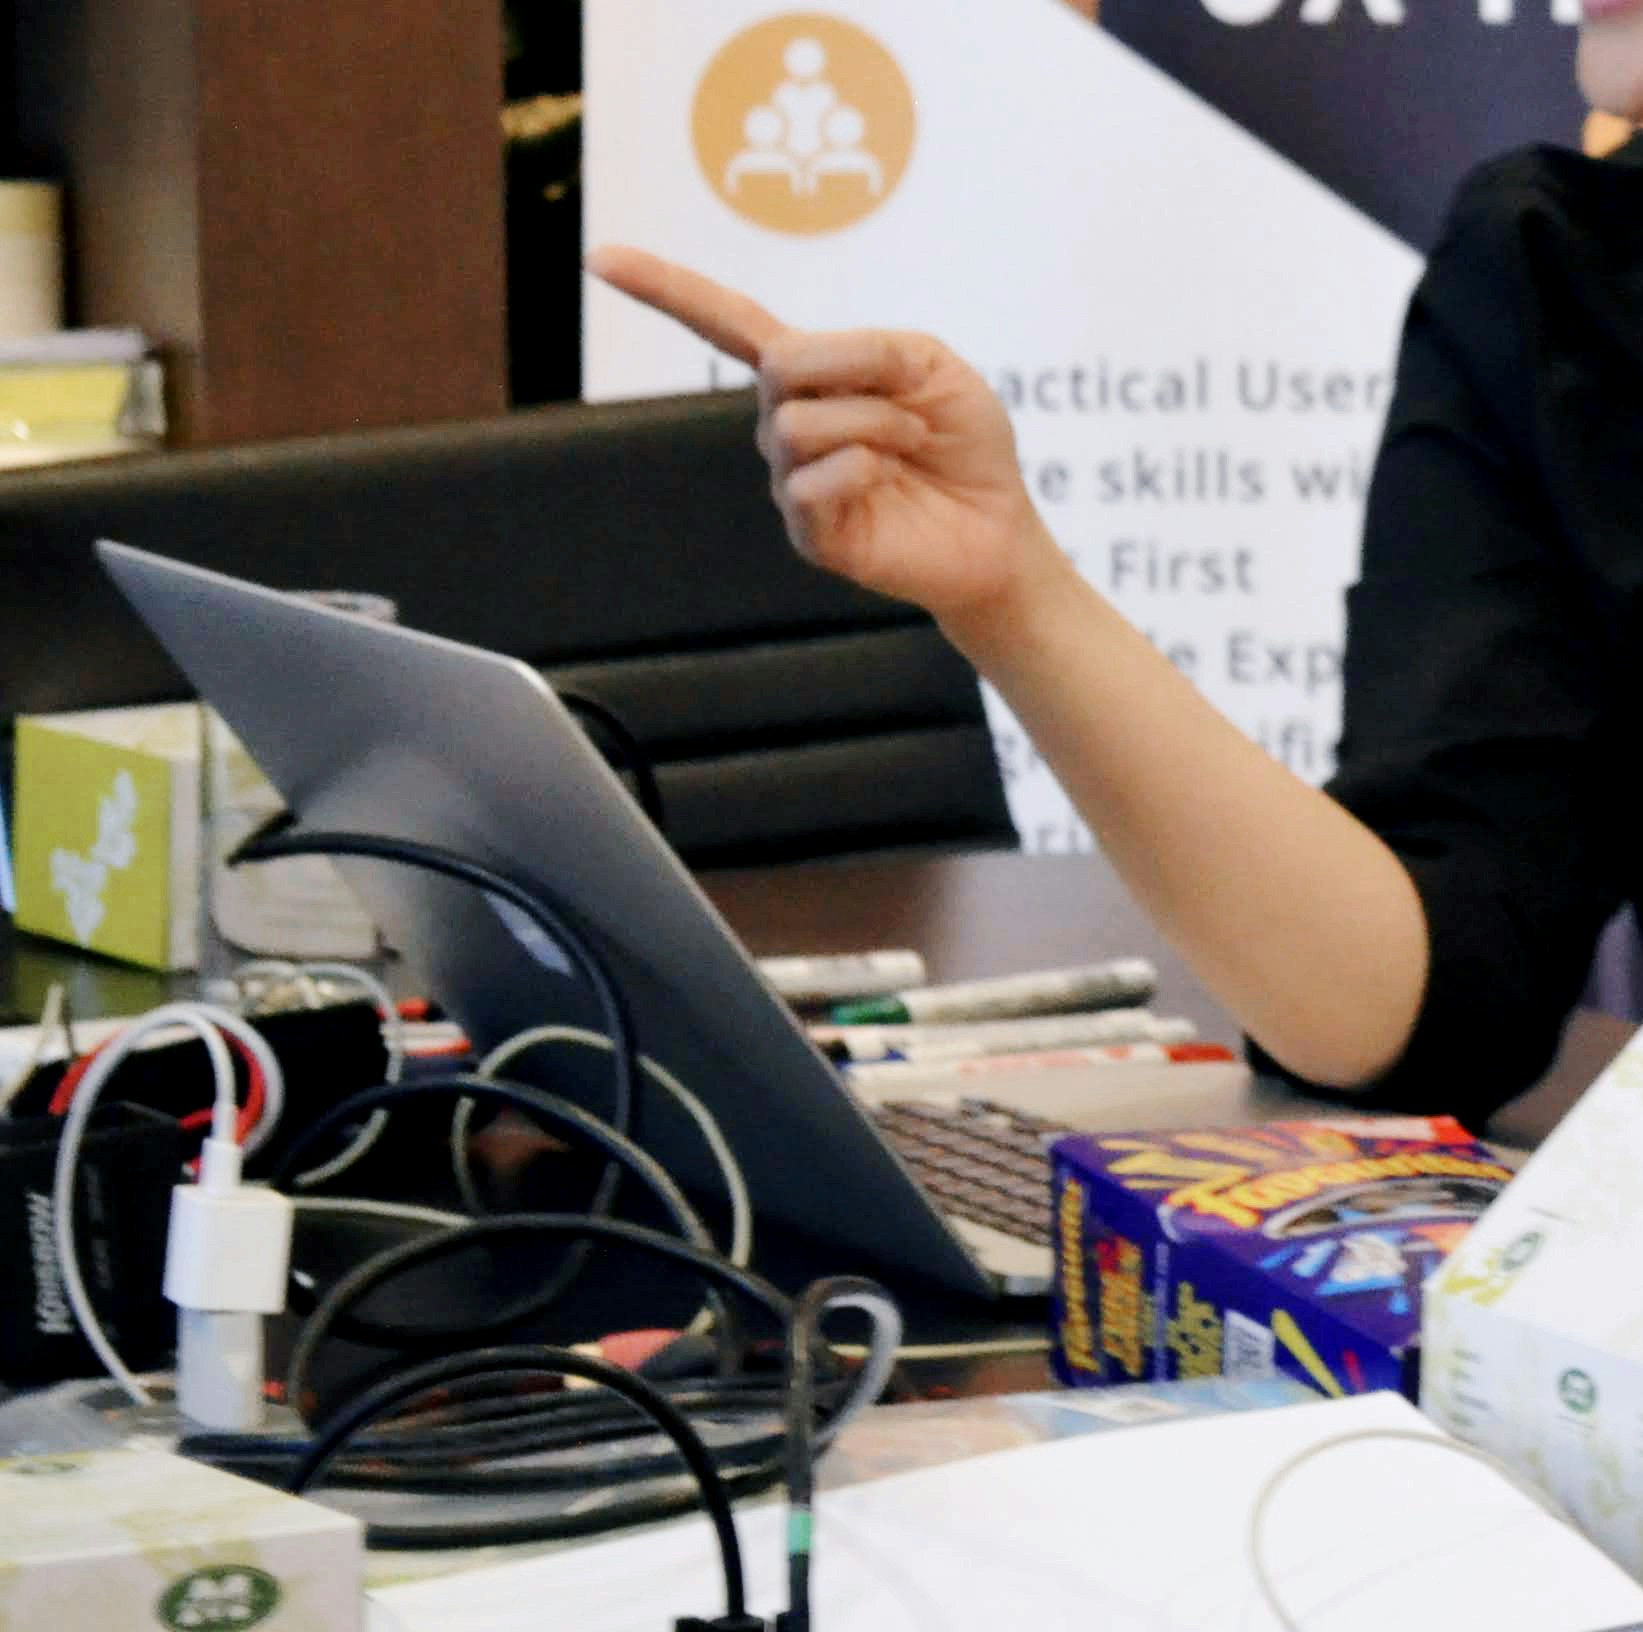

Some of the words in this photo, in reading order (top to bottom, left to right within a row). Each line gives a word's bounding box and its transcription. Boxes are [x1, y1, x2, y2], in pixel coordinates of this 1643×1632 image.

[1002, 358, 1209, 412] actical
[1097, 450, 1265, 504] skills
[1293, 451, 1366, 503] wi
[1110, 536, 1255, 595] First
[1228, 631, 1341, 696] Exp
